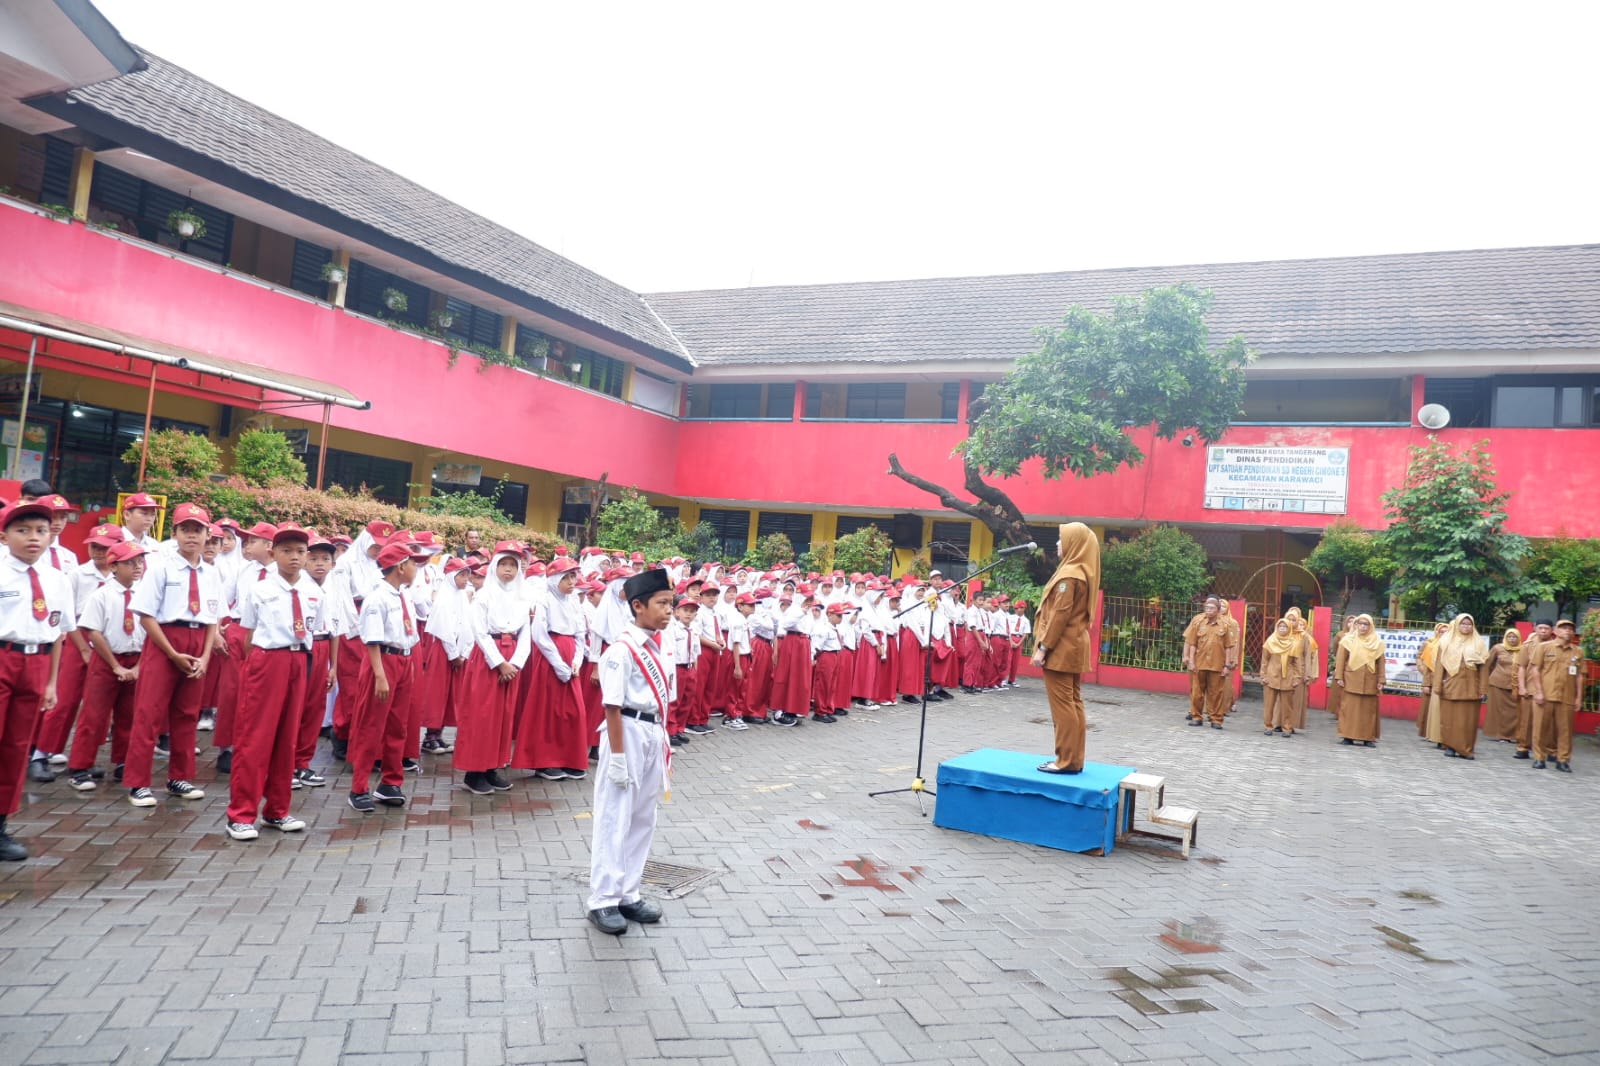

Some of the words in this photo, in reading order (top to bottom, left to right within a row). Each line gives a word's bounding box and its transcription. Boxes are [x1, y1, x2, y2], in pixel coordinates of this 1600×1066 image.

[1263, 456, 1315, 464] PENDIDIKAN
[1208, 464, 1220, 473] UPT
[1220, 464, 1243, 474] SATUAN
[1244, 464, 1280, 475] PENDIDIKAN
[1291, 466, 1314, 476] NEGERI
[1228, 475, 1277, 483] KECAMATAN
[1279, 476, 1323, 484] KARAWACI
[1380, 634, 1429, 642] TAKAN
[641, 651, 663, 689] PEMIMPIN
